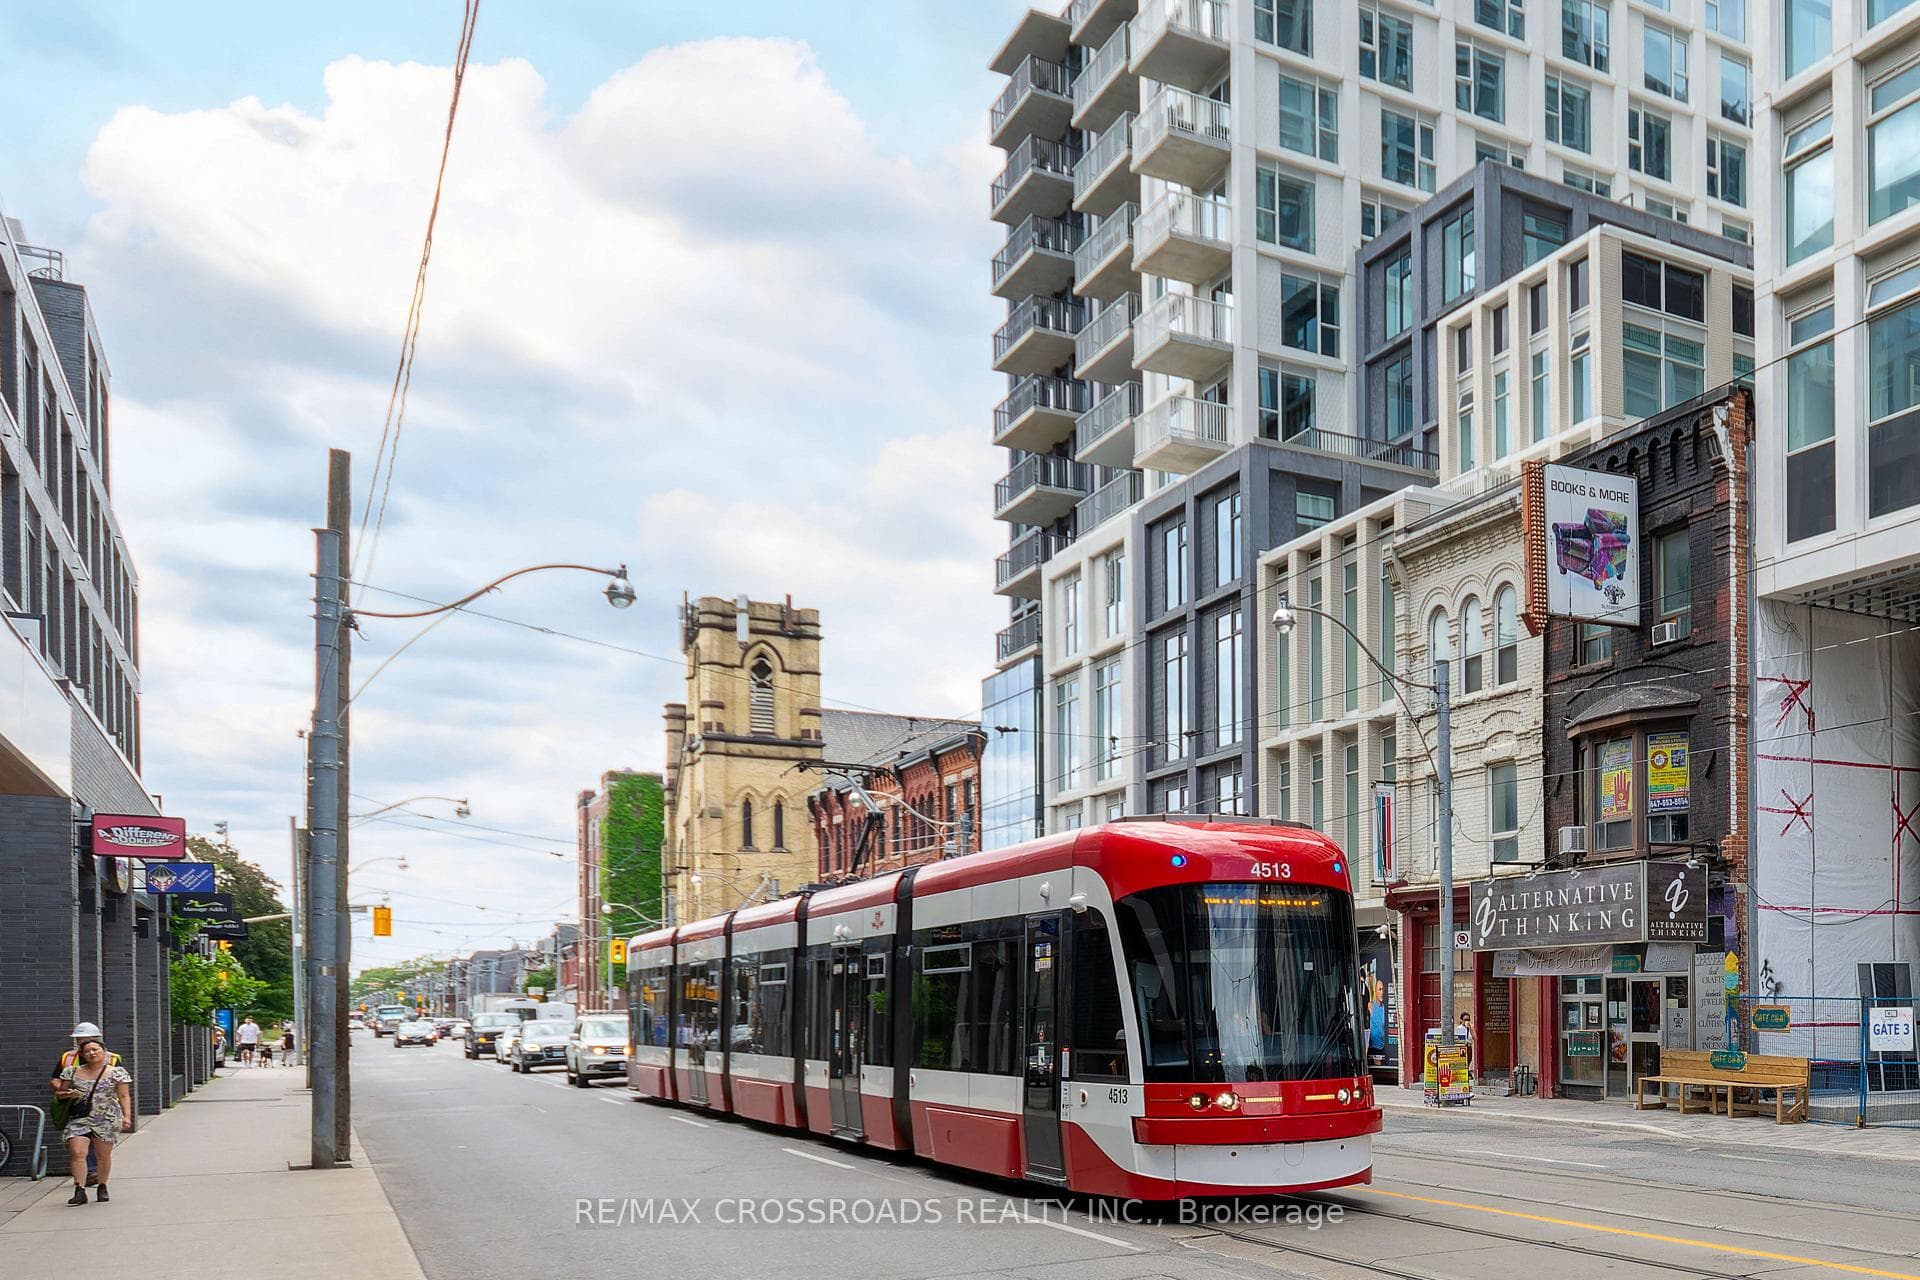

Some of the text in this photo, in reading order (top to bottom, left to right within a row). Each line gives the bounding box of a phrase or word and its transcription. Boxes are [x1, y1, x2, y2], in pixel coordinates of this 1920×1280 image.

[1551, 479, 1629, 503] BOOKS & MORE
[97, 829, 111, 837] A
[1250, 862, 1291, 878] 4513
[1498, 882, 1634, 912] ALTERNATIVE
[1650, 921, 1704, 929] ALTERNATIVE
[1701, 975, 1725, 984] CRAFTS
[1873, 1023, 1910, 1036] GATE 3
[1108, 1087, 1128, 1104] 4513
